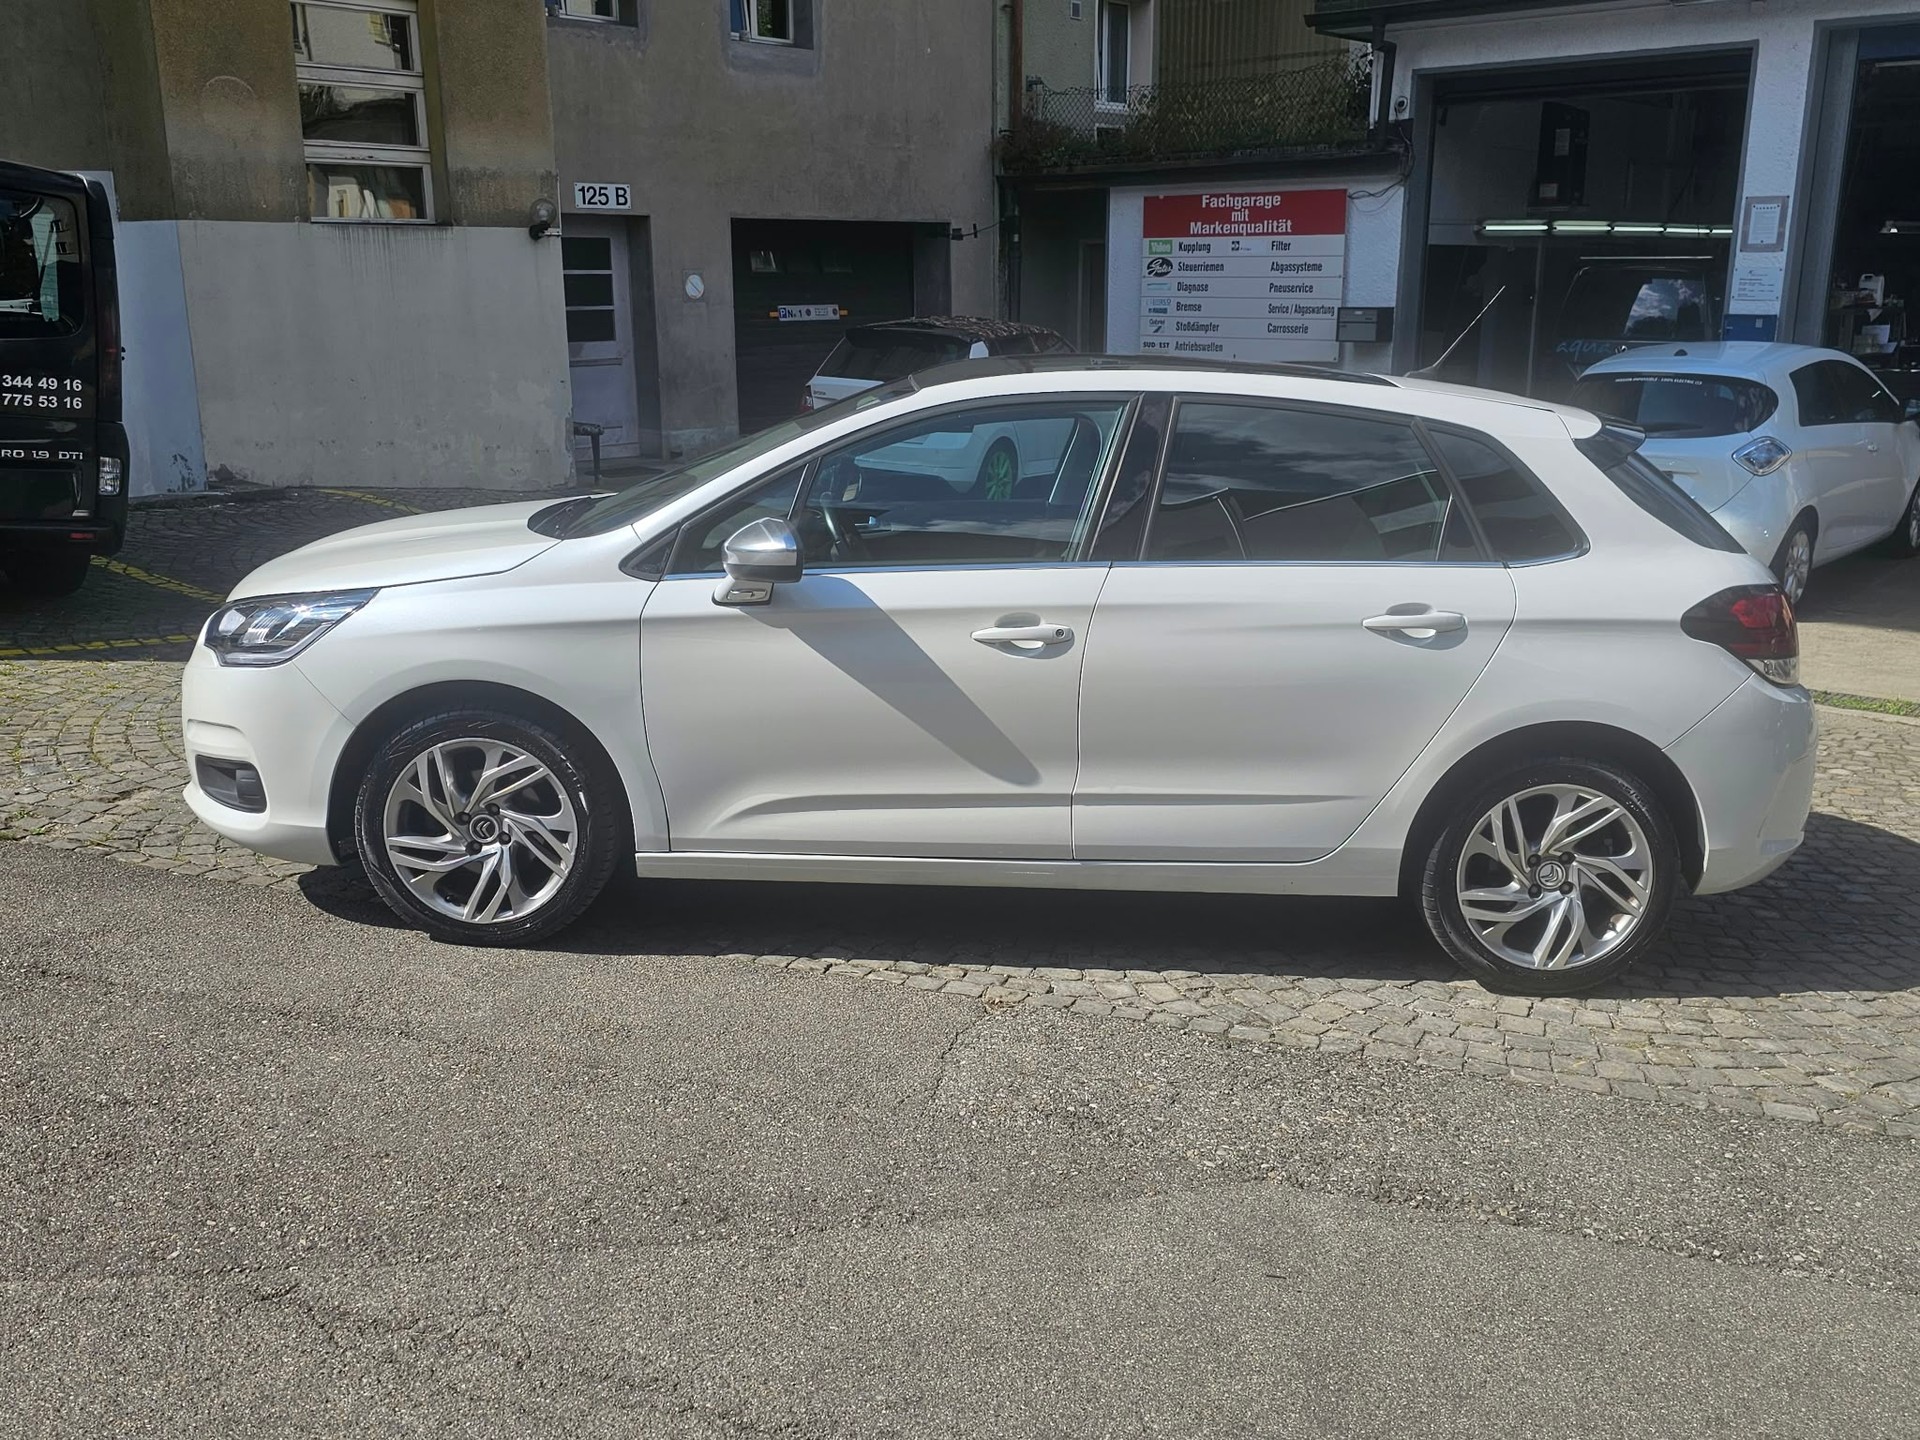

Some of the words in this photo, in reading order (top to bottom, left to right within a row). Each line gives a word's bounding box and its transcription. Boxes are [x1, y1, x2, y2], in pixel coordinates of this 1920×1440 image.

[578, 185, 610, 206] 125
[615, 186, 628, 206] B
[1201, 194, 1281, 210] Fachgarage
[1231, 208, 1249, 222] mit
[1189, 219, 1292, 236] Markenqualität
[1178, 241, 1211, 254] Kupplung
[1271, 240, 1291, 252] Filter
[1177, 261, 1225, 273] Steuerriemen
[1270, 261, 1323, 274] Abgassysteme
[1176, 281, 1209, 294] Diagnose
[1269, 282, 1314, 294] Pneuservice
[1176, 301, 1202, 312] Bremse
[1267, 303, 1289, 315] Service
[1294, 304, 1335, 317] Abgaswartung
[1267, 322, 1309, 335] Carrosserie
[1174, 340, 1224, 353] Antriebswellen
[2, 374, 33, 389] 344
[38, 377, 58, 390] 49
[63, 378, 82, 391] 16
[2, 393, 33, 407] 775
[38, 395, 58, 408] 53
[63, 397, 82, 409] 16
